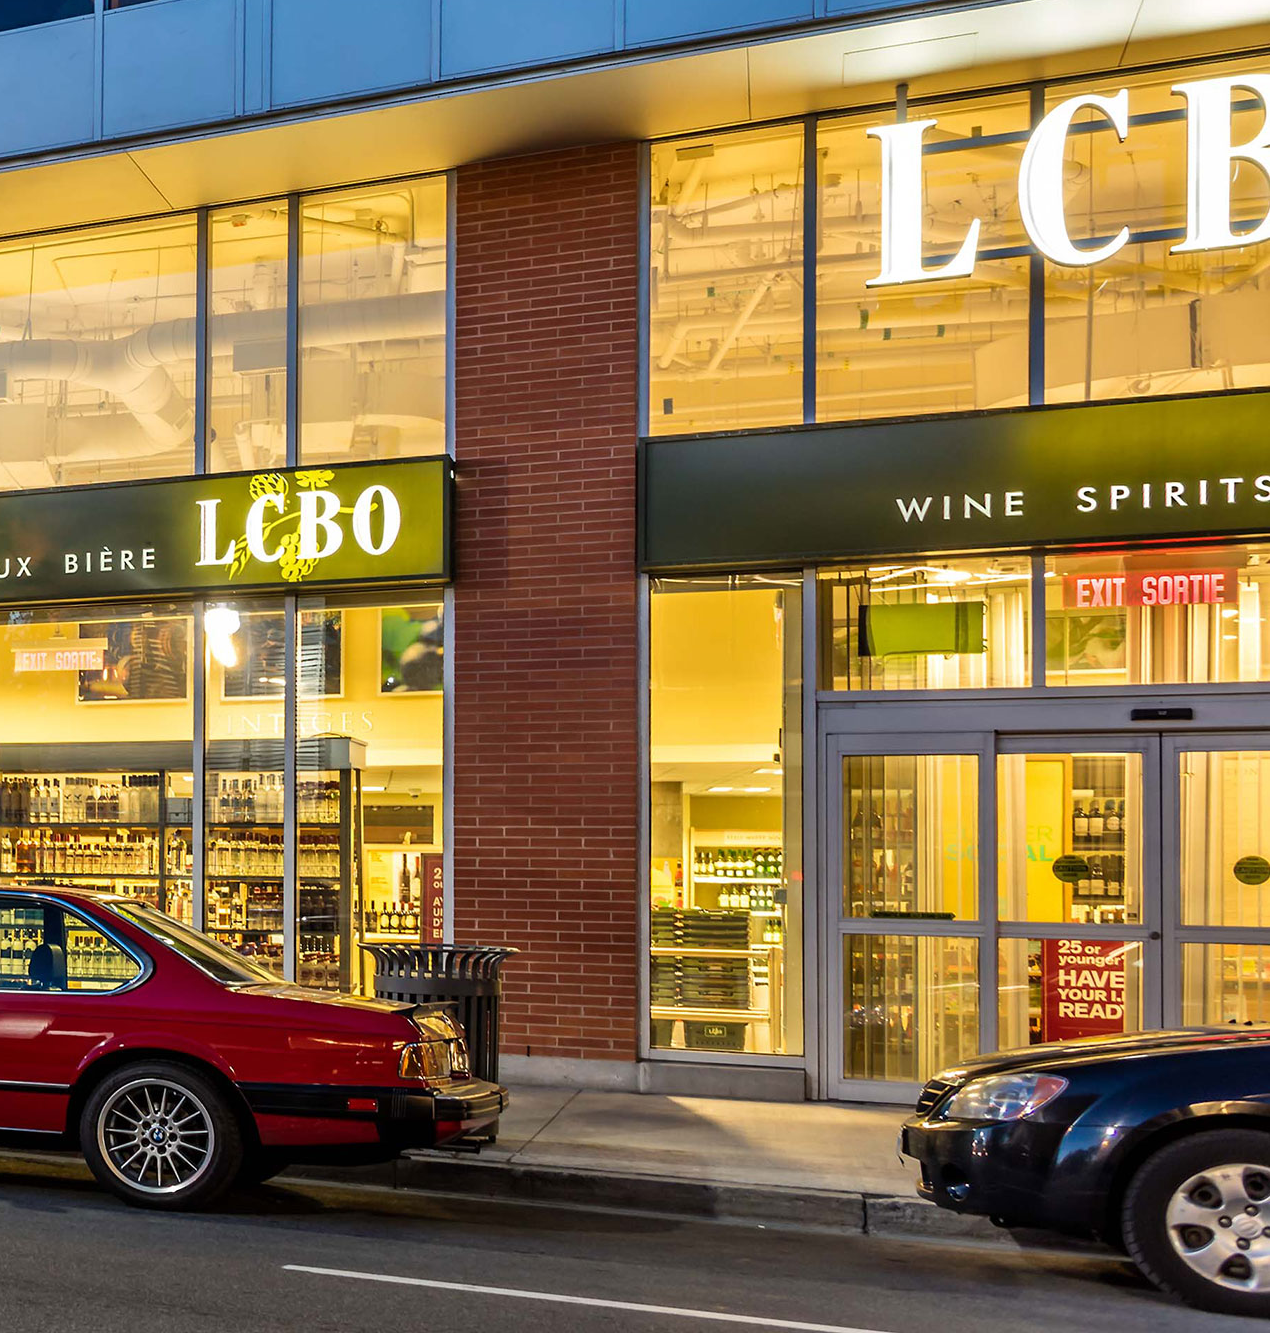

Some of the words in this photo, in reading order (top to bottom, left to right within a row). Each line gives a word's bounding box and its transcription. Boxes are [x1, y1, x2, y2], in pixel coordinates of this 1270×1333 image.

[866, 73, 1270, 289] LCB
[895, 491, 1024, 523] WINE
[1075, 475, 1270, 513] SPIRITS
[195, 485, 401, 566] LCBO
[64, 546, 157, 575] BIÈRE
[1076, 577, 1126, 608] EXIT
[1142, 573, 1225, 605] SORTIE
[22, 652, 47, 670] EXIT
[55, 651, 96, 670] SORTIE
[215, 710, 373, 735] INTGES
[1058, 939, 1082, 954] 25
[1084, 945, 1101, 954] or
[1058, 969, 1124, 988] HAVE
[1057, 988, 1107, 1002] YOUR
[1111, 990, 1124, 1003] I.
